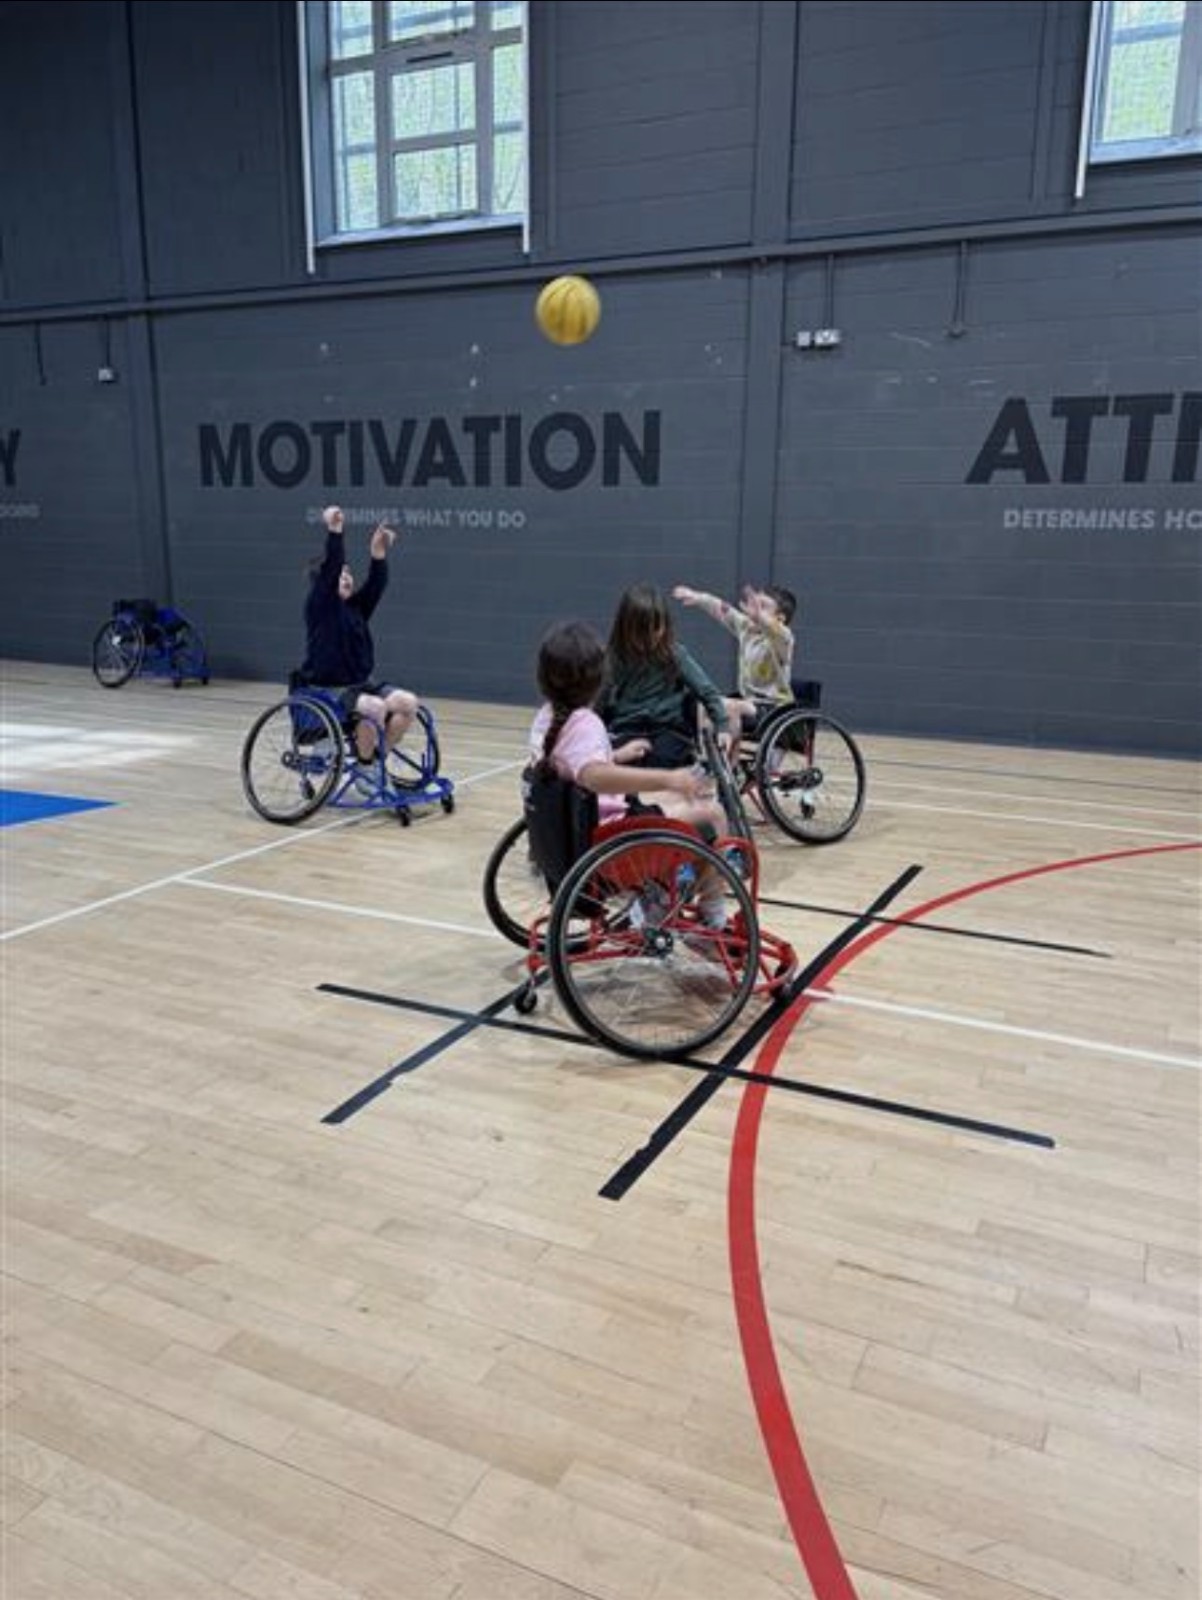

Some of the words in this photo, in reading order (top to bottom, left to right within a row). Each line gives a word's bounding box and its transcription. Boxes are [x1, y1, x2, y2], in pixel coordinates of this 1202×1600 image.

[198, 409, 661, 491] MOTIVATION
[964, 391, 1202, 485] ATTI
[403, 507, 452, 527] WHAT
[455, 507, 492, 529] YOU
[497, 509, 527, 530] DO
[1003, 507, 1156, 530] DETERMINES
[1163, 508, 1202, 531] HO
